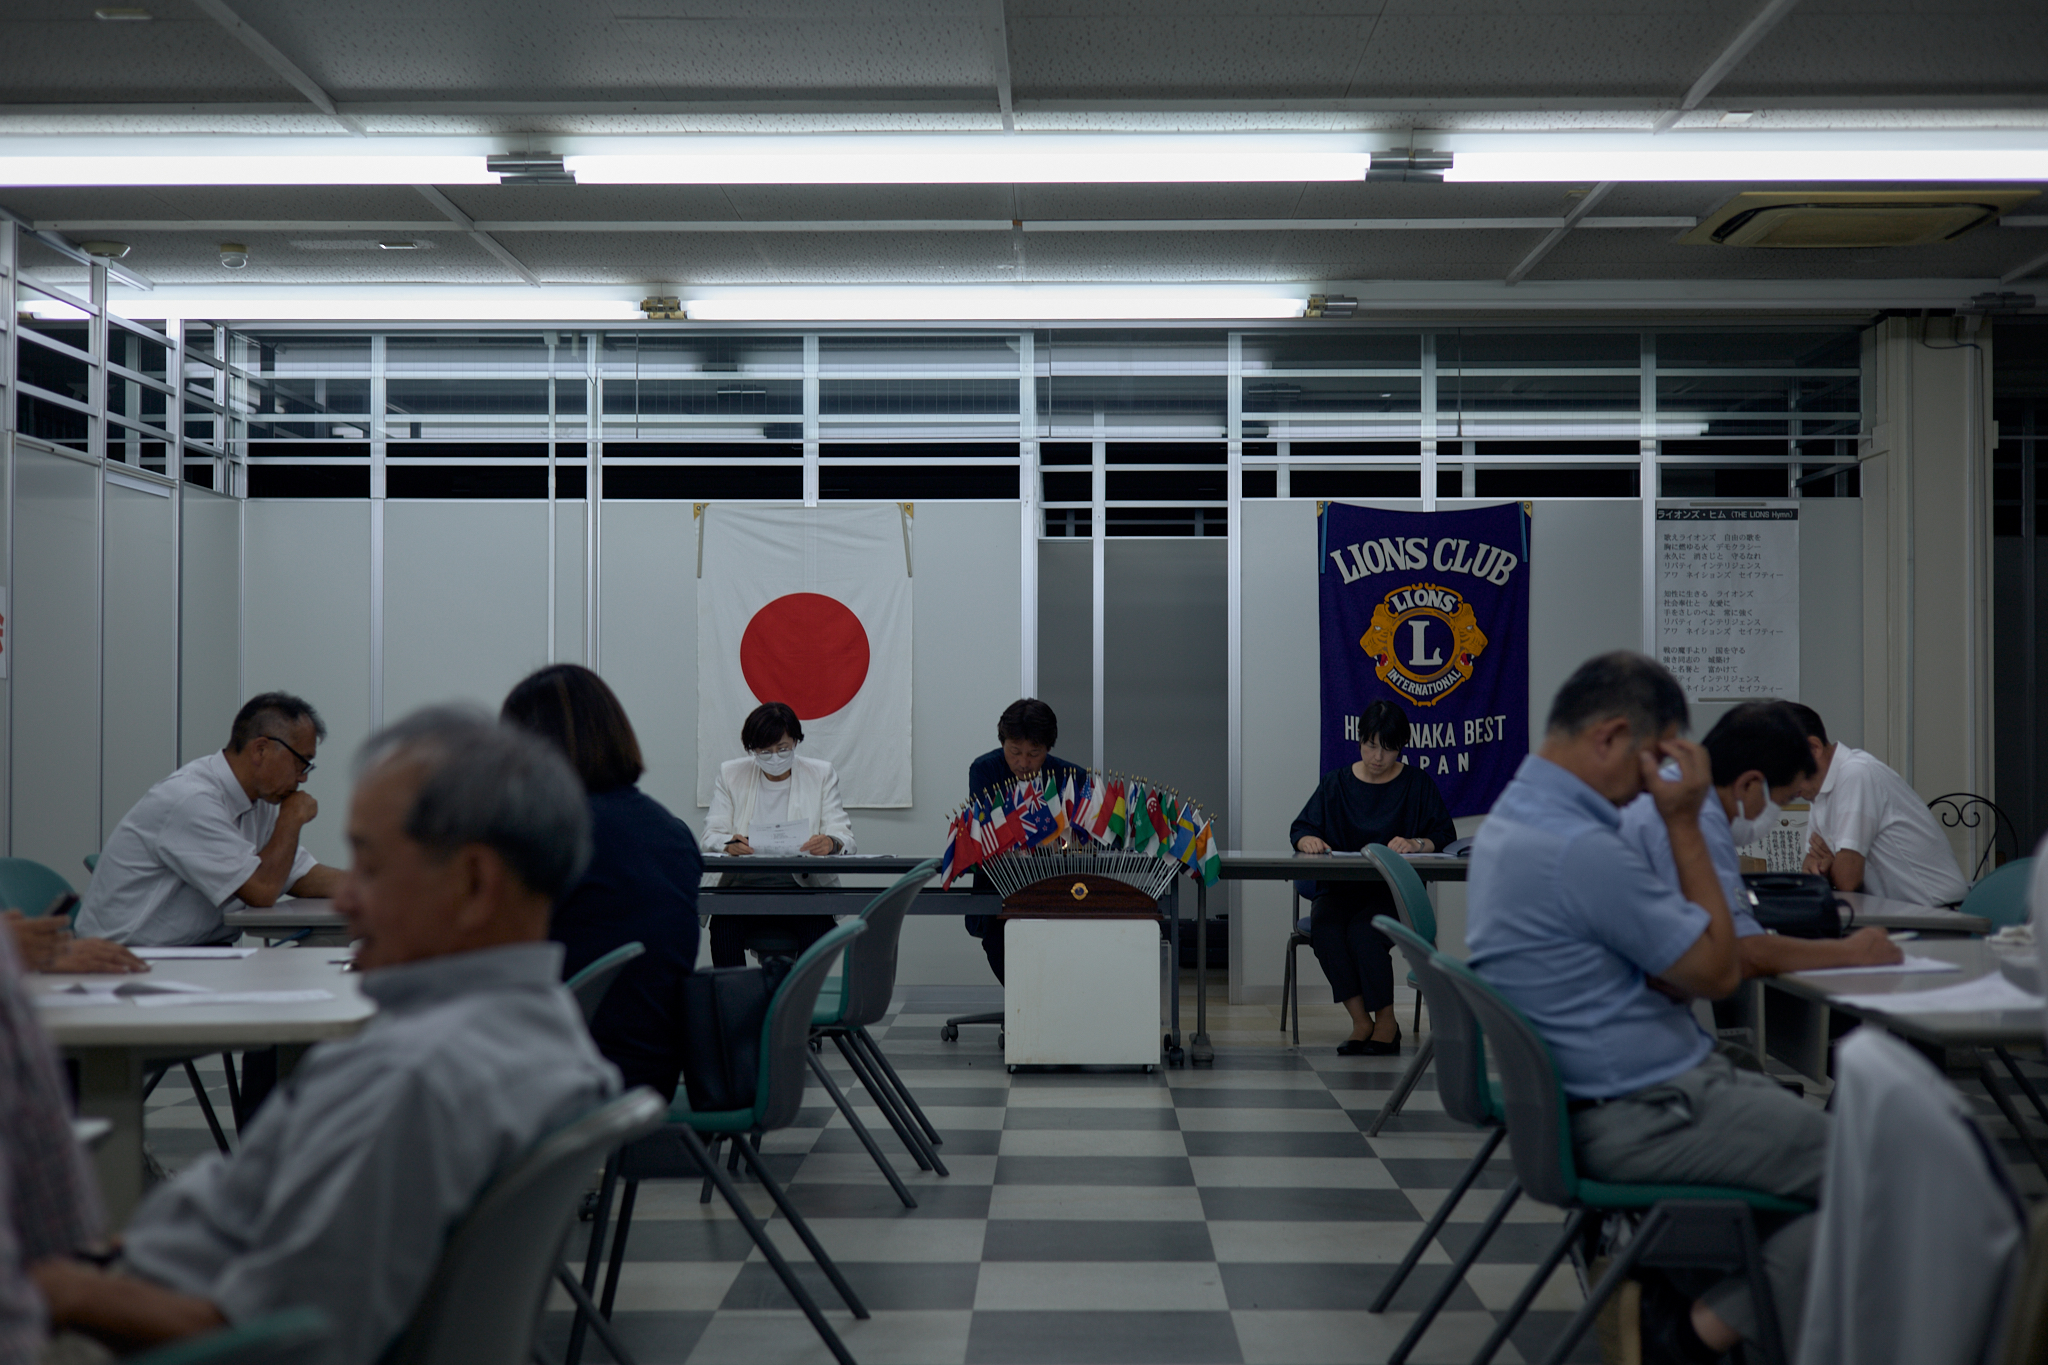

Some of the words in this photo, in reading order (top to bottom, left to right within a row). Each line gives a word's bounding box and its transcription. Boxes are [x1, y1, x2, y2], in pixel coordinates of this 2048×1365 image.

[1658, 510, 1726, 519] ライオンズ・ヒム
[1330, 536, 1428, 585] LIONS
[1432, 538, 1518, 586] CLUB
[1390, 589, 1457, 613] LIONS
[1716, 590, 1754, 598] ライオンズ
[1701, 618, 1761, 626] インテリジェンス
[1408, 620, 1443, 666] L
[1387, 668, 1461, 696] INTERNATIONAL
[1464, 715, 1506, 746] BEST
[1401, 752, 1469, 775] APAN
